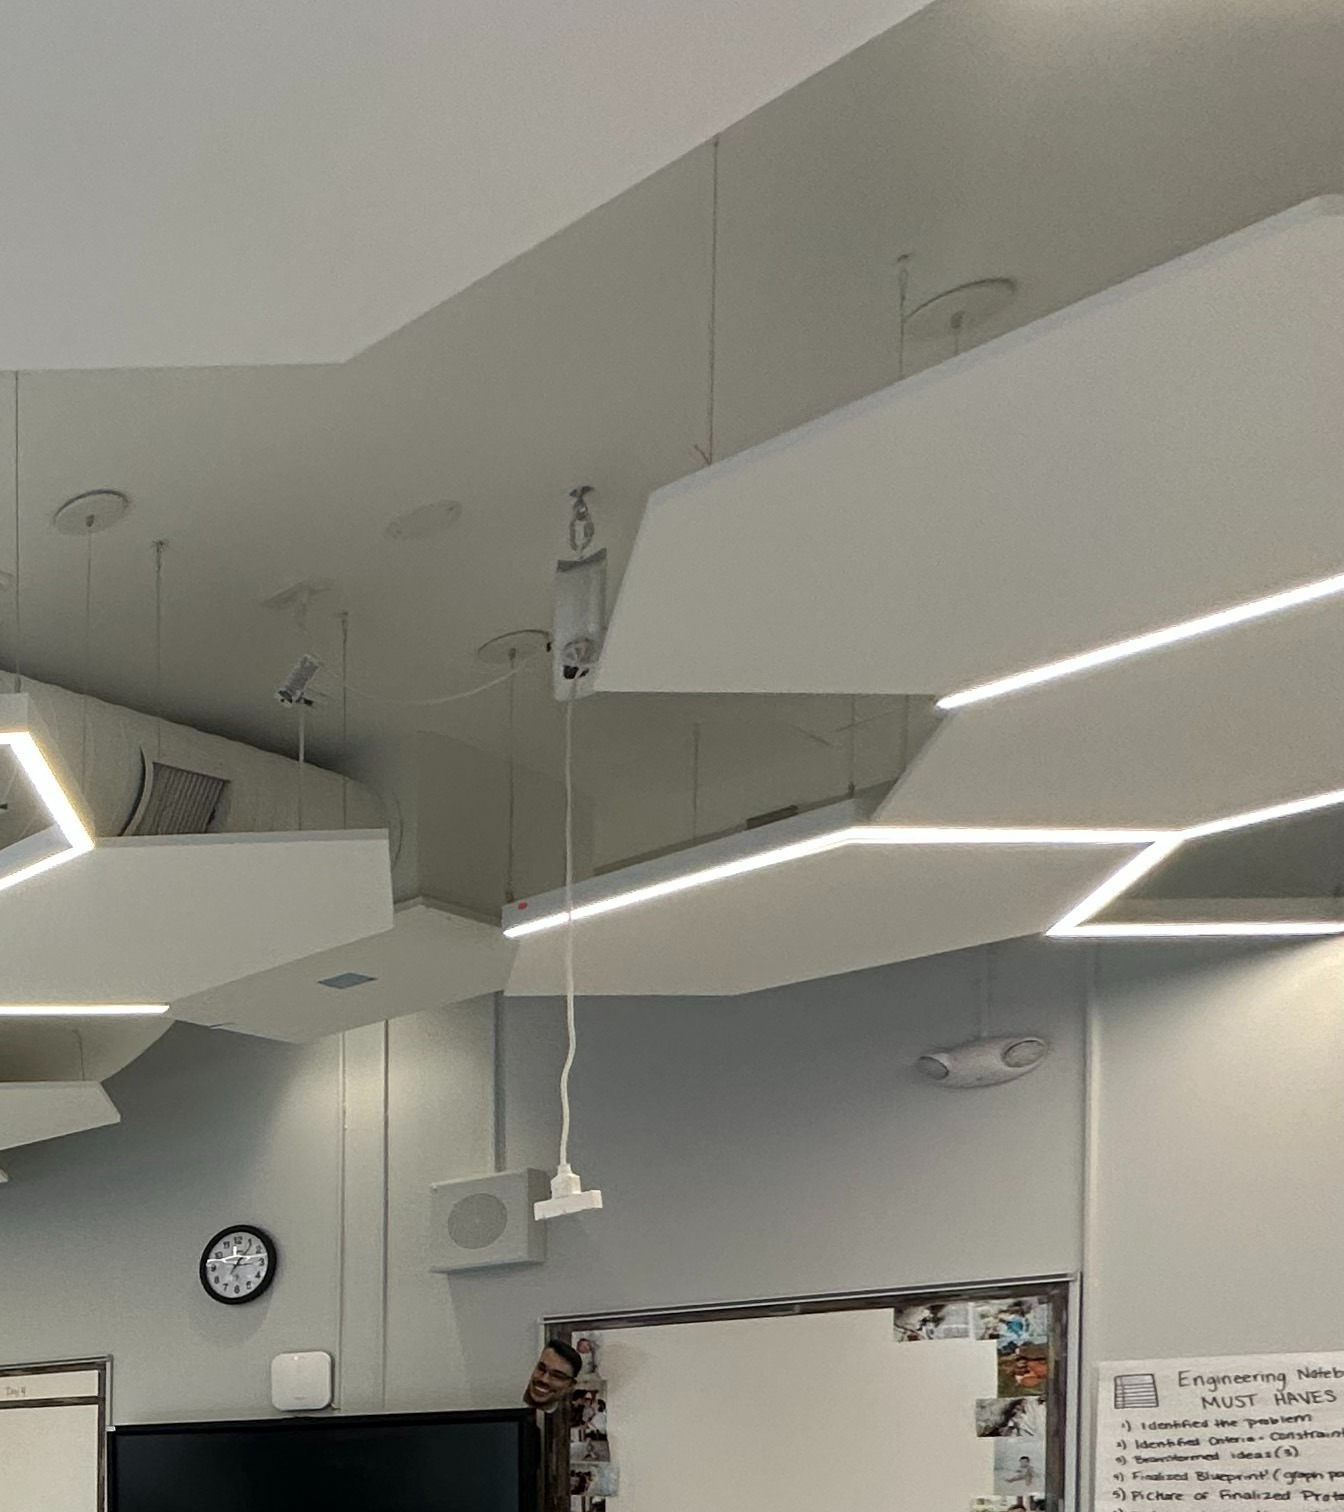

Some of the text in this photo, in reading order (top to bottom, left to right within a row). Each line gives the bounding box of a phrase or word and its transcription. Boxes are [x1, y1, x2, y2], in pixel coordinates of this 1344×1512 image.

[1178, 1370, 1287, 1392] Engineering
[1201, 1390, 1338, 1410] MUST HAVES
[1141, 1419, 1209, 1431] Identified
[1213, 1418, 1238, 1429] the
[1135, 1437, 1201, 1450] Identified
[1112, 1489, 1126, 1501] 5)
[1131, 1490, 1185, 1501] Picture
[1193, 1491, 1210, 1501] of
[1219, 1489, 1292, 1501] Finalized
